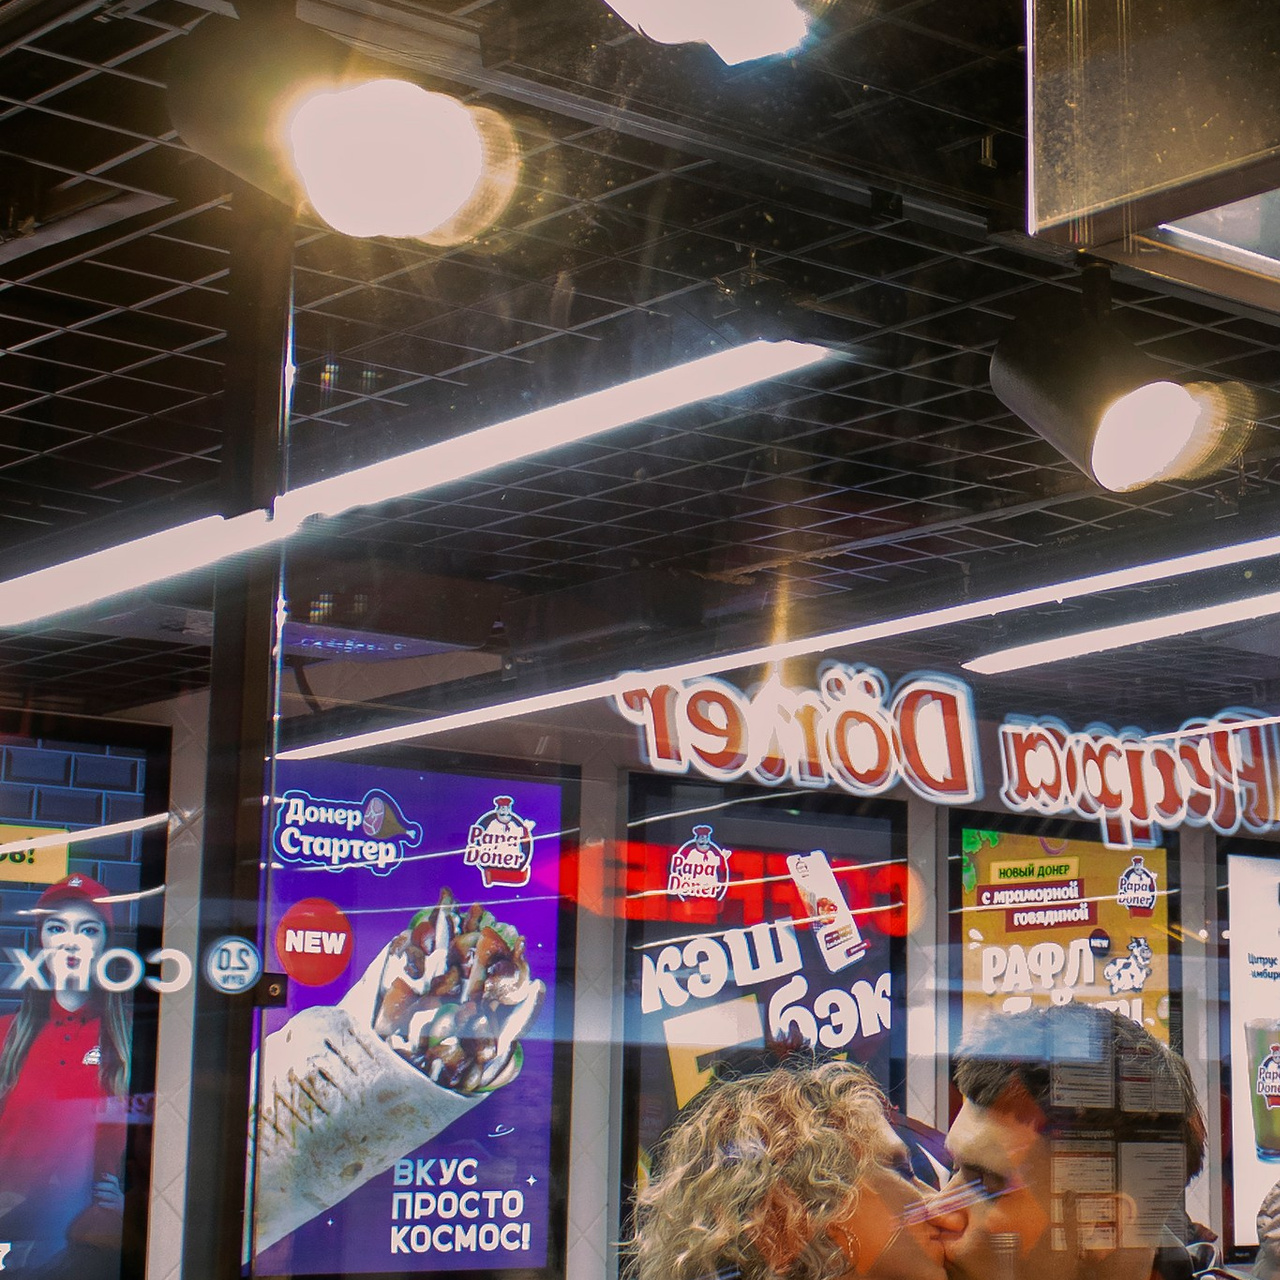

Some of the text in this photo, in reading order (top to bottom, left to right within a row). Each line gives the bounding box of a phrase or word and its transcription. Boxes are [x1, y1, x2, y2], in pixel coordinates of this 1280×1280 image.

[286, 798, 363, 831] Донер
[281, 827, 396, 867] Стартер
[471, 828, 520, 850] Papa
[467, 846, 524, 866] Döner
[672, 856, 716, 878] Papa
[998, 864, 1070, 878] НОВЫЙ ДОНЕР
[670, 875, 720, 895] Döner
[993, 881, 1079, 906] мраморной
[1120, 878, 1147, 892] Papa
[1013, 903, 1090, 926] говядиной
[284, 930, 346, 956] NEW
[1090, 938, 1109, 948] NEW
[982, 938, 1096, 995] РАФЛ
[1247, 953, 1278, 967] Цитрус
[393, 1159, 478, 1187] ВКУС
[392, 1191, 524, 1220] ПРОСТО
[390, 1222, 531, 1254] КОСМОС!
